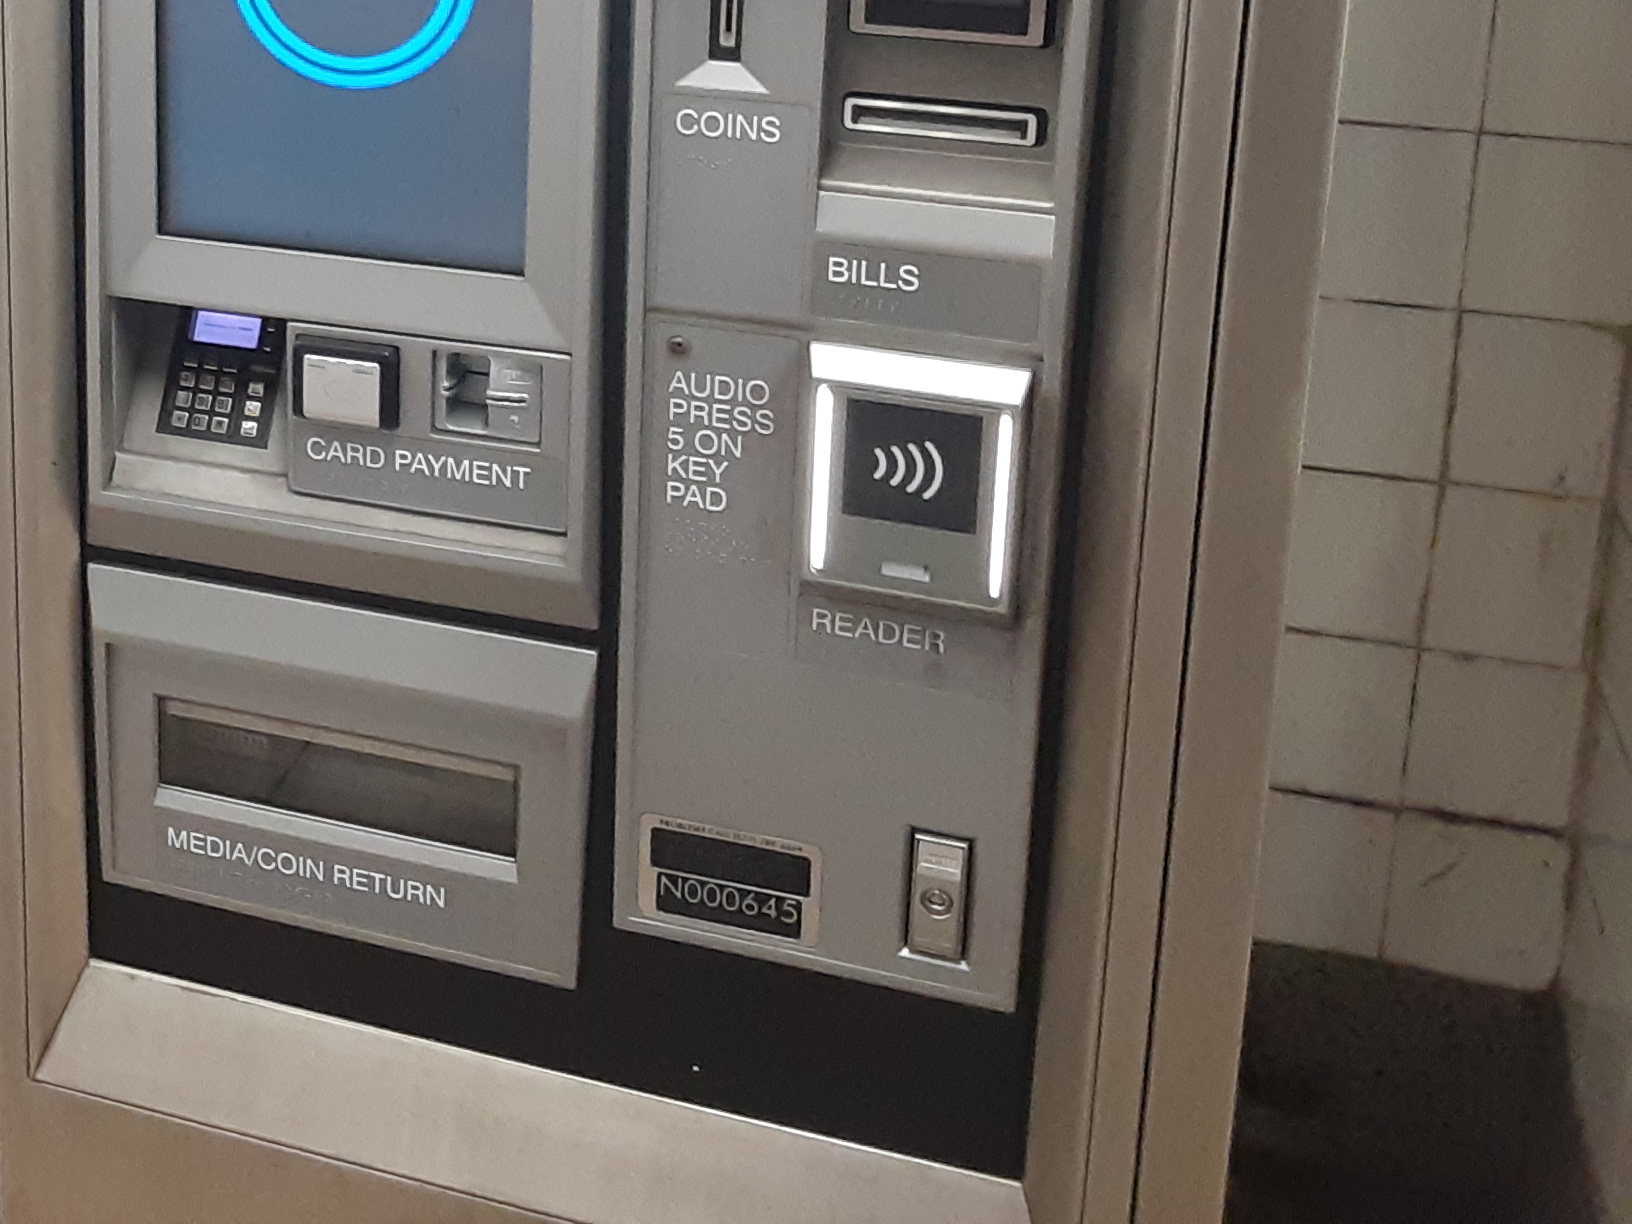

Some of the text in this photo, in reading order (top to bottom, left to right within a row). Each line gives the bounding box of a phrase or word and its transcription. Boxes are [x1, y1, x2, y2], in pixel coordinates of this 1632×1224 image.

[675, 108, 782, 143] COINS
[827, 256, 920, 292] BILLS
[668, 370, 770, 405] AUDIO
[669, 397, 775, 435] PRESS
[667, 426, 742, 458] 5 ON
[306, 437, 532, 489] CARD PAYMENT
[667, 453, 729, 483] KEY
[666, 481, 728, 512] PAD
[811, 607, 945, 654] READER
[167, 826, 447, 910] MEDIA/COIN RETURN
[659, 874, 799, 924] N000645
